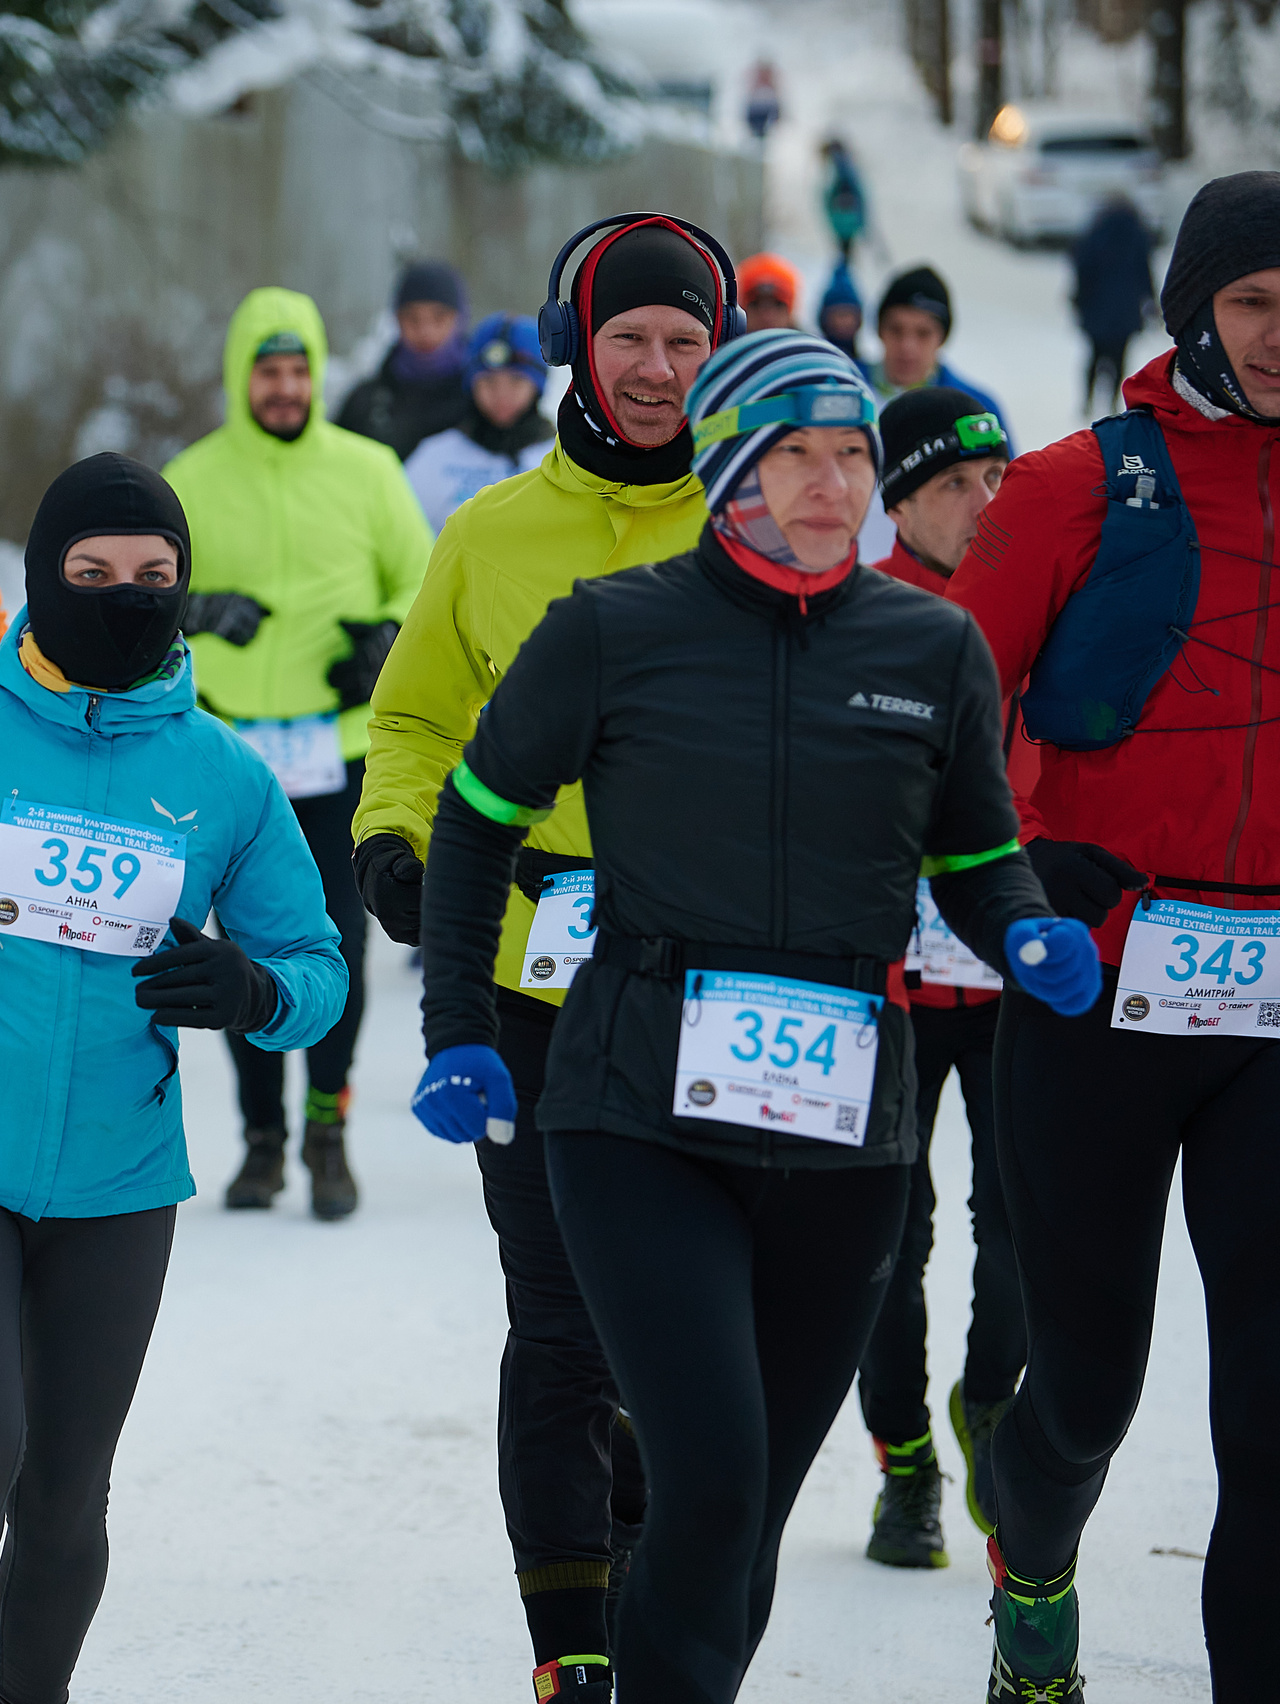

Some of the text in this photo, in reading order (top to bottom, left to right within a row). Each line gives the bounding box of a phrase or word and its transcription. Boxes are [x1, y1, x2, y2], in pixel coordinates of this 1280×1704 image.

[870, 693, 935, 720] TERREX
[13, 816, 51, 831] "WINTER
[53, 822, 93, 839] EXTREME
[95, 829, 122, 846] ULTRA
[124, 835, 148, 850] TRAIL
[28, 807, 163, 843] 2-й зимний ультрамарафон
[34, 837, 141, 900] 359
[562, 875, 575, 884] 2-й
[65, 895, 98, 910] АННА
[1158, 903, 1174, 913] 2-й
[1176, 907, 1212, 920] зимний
[1144, 912, 1180, 926] "WINTER
[1183, 920, 1223, 933] EXTREME
[1225, 926, 1250, 935] ULTRA
[1253, 927, 1273, 935] TRAIL
[1165, 933, 1267, 985] 343
[1184, 987, 1236, 998] ДМИТРИЙ
[730, 1009, 836, 1076] 354
[763, 1071, 799, 1086] ЕЛЕНА
